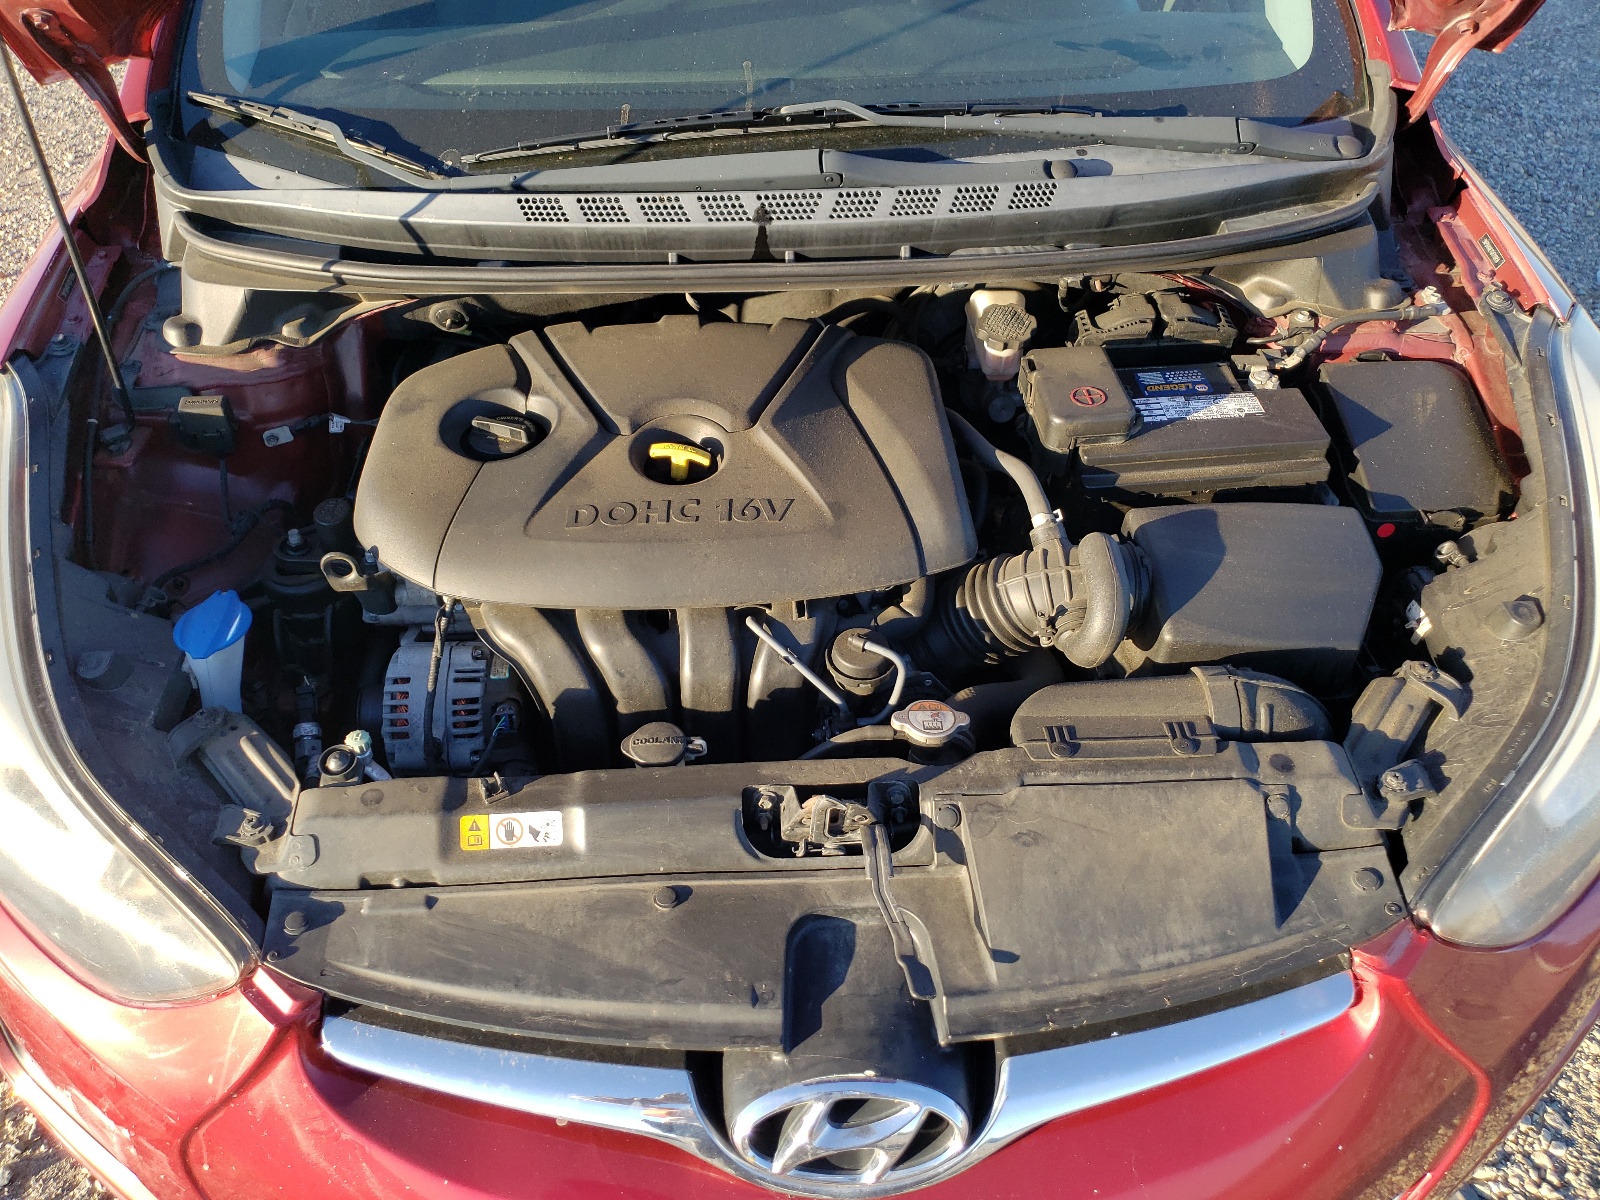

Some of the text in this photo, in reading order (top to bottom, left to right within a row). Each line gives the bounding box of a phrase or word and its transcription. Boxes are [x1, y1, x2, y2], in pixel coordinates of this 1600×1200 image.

[1146, 383, 1193, 392] LEGEND
[565, 498, 796, 530] DOHC 16V
